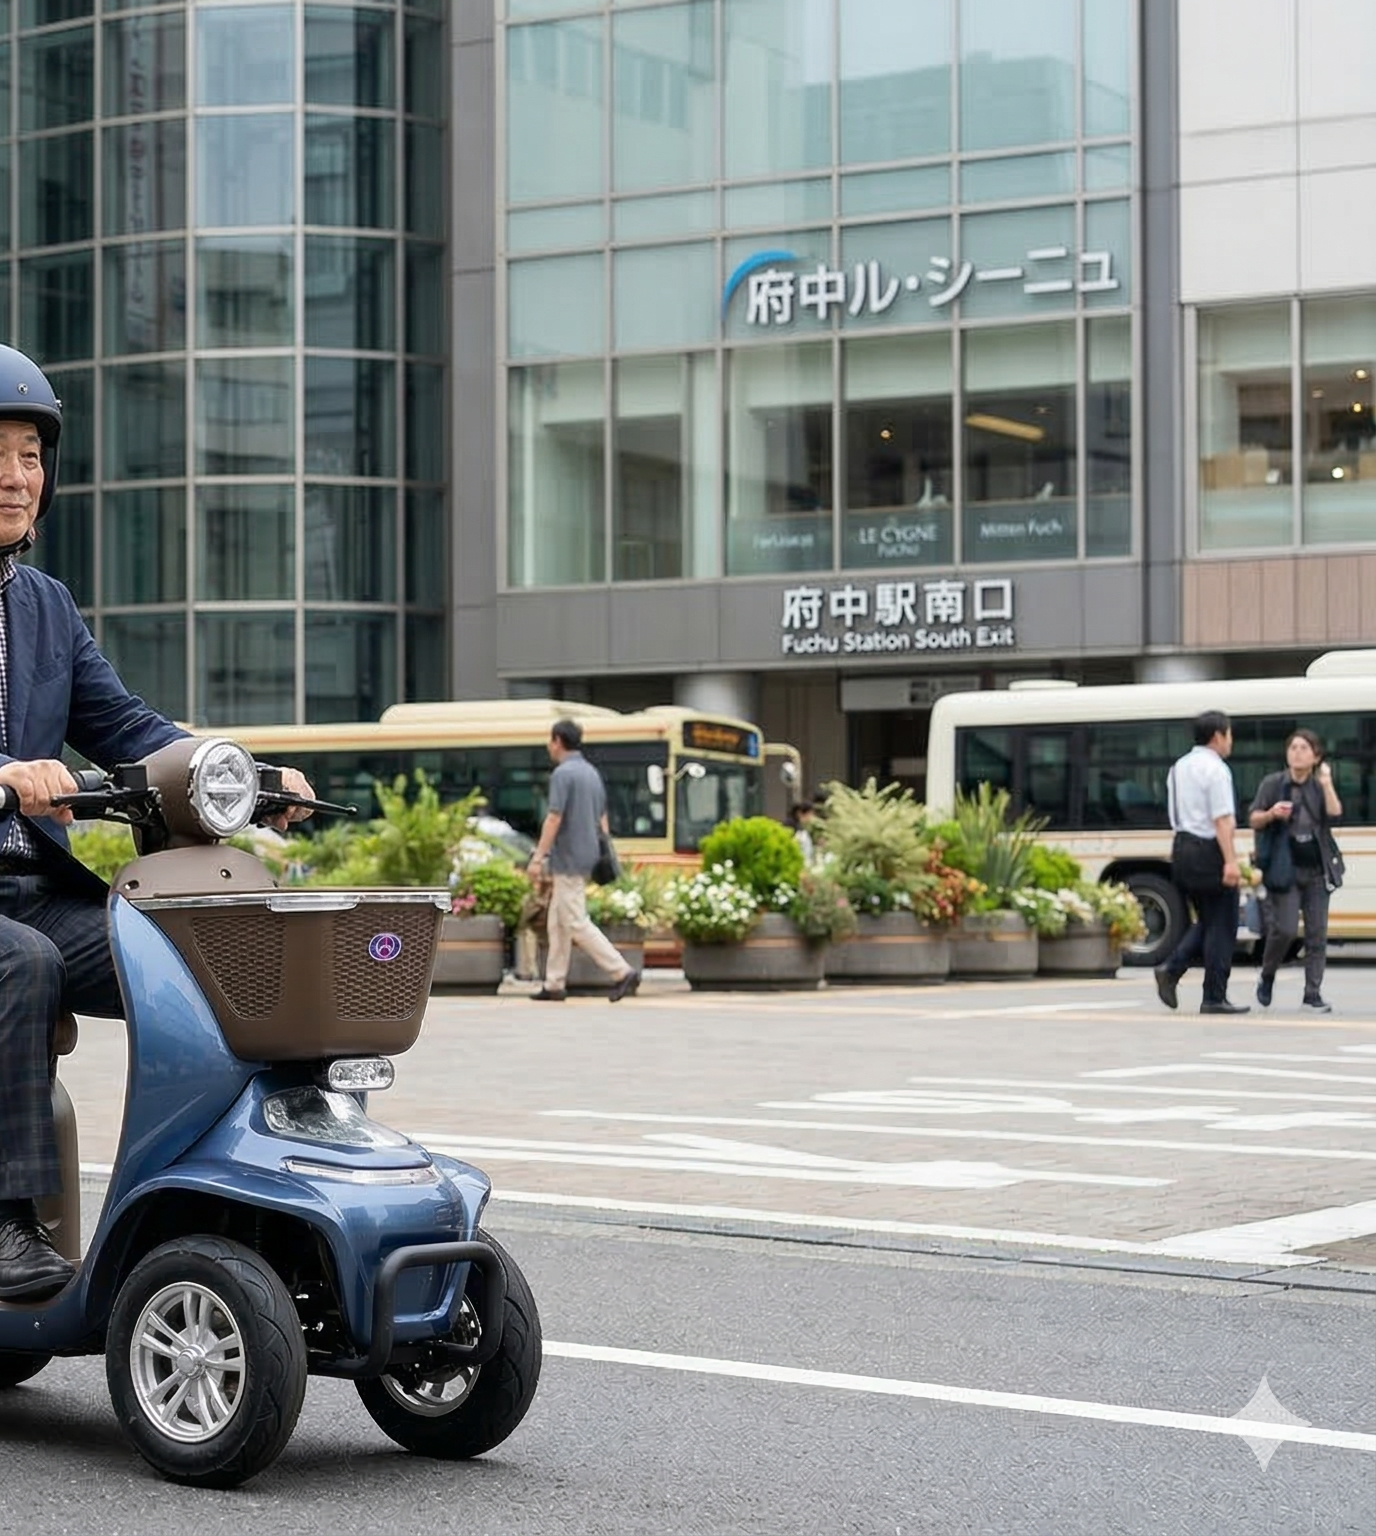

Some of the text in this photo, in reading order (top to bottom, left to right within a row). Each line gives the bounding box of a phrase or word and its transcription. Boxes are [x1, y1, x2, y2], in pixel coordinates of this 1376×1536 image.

[858, 527, 878, 545] LE
[781, 578, 1013, 629] 府中駅南口
[782, 625, 1015, 654] Fuchu Station South Exit
